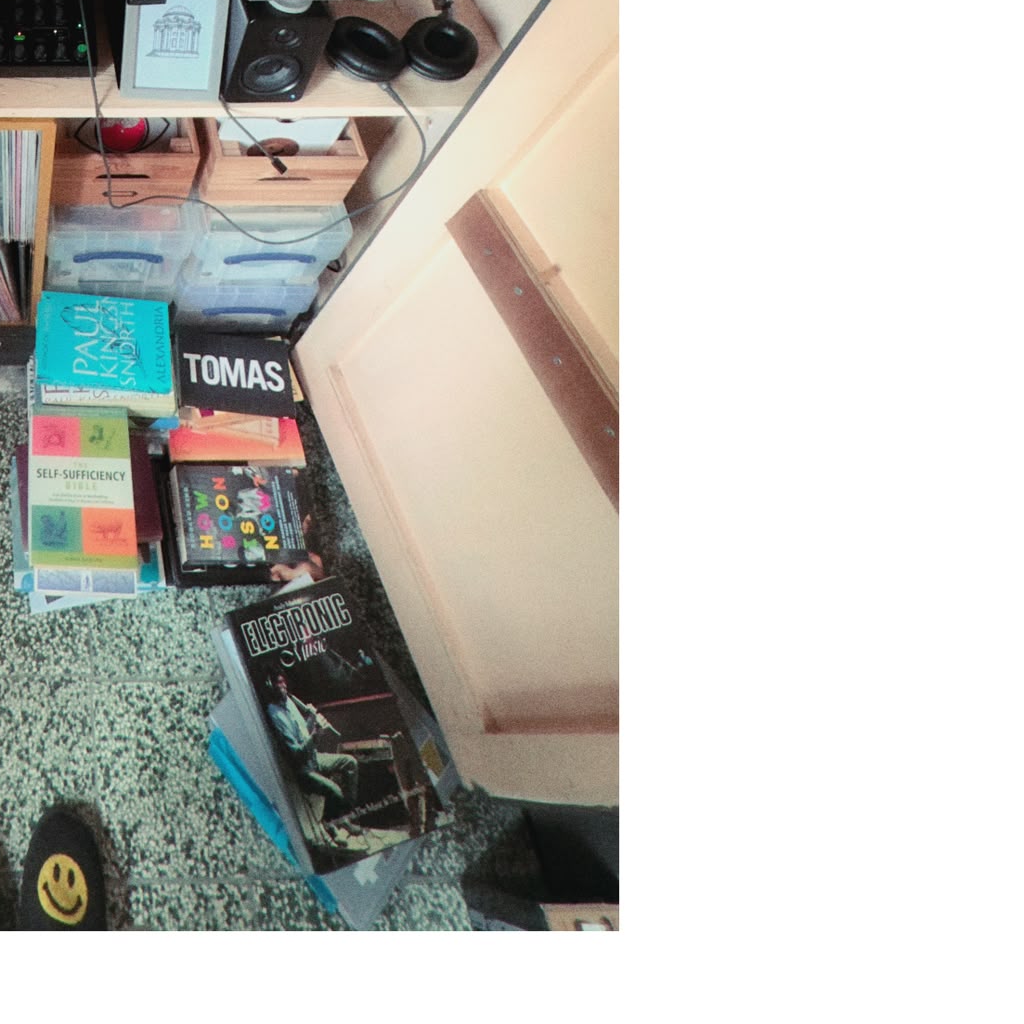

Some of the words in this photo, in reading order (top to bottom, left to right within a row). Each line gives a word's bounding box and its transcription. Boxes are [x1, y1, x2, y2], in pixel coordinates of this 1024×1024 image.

[74, 299, 102, 376] PAUL
[154, 306, 170, 384] ALEXANDRIA
[183, 352, 286, 393] TOMAS
[36, 468, 126, 481] SELF-SUFFICIENCY
[65, 481, 97, 490] BIBLE
[193, 490, 215, 549] HOW
[212, 476, 236, 549] SOON
[240, 520, 259, 550] IS
[253, 475, 280, 550] NOW?
[241, 593, 352, 657] ELECTRONIC
[279, 634, 327, 667] Music
